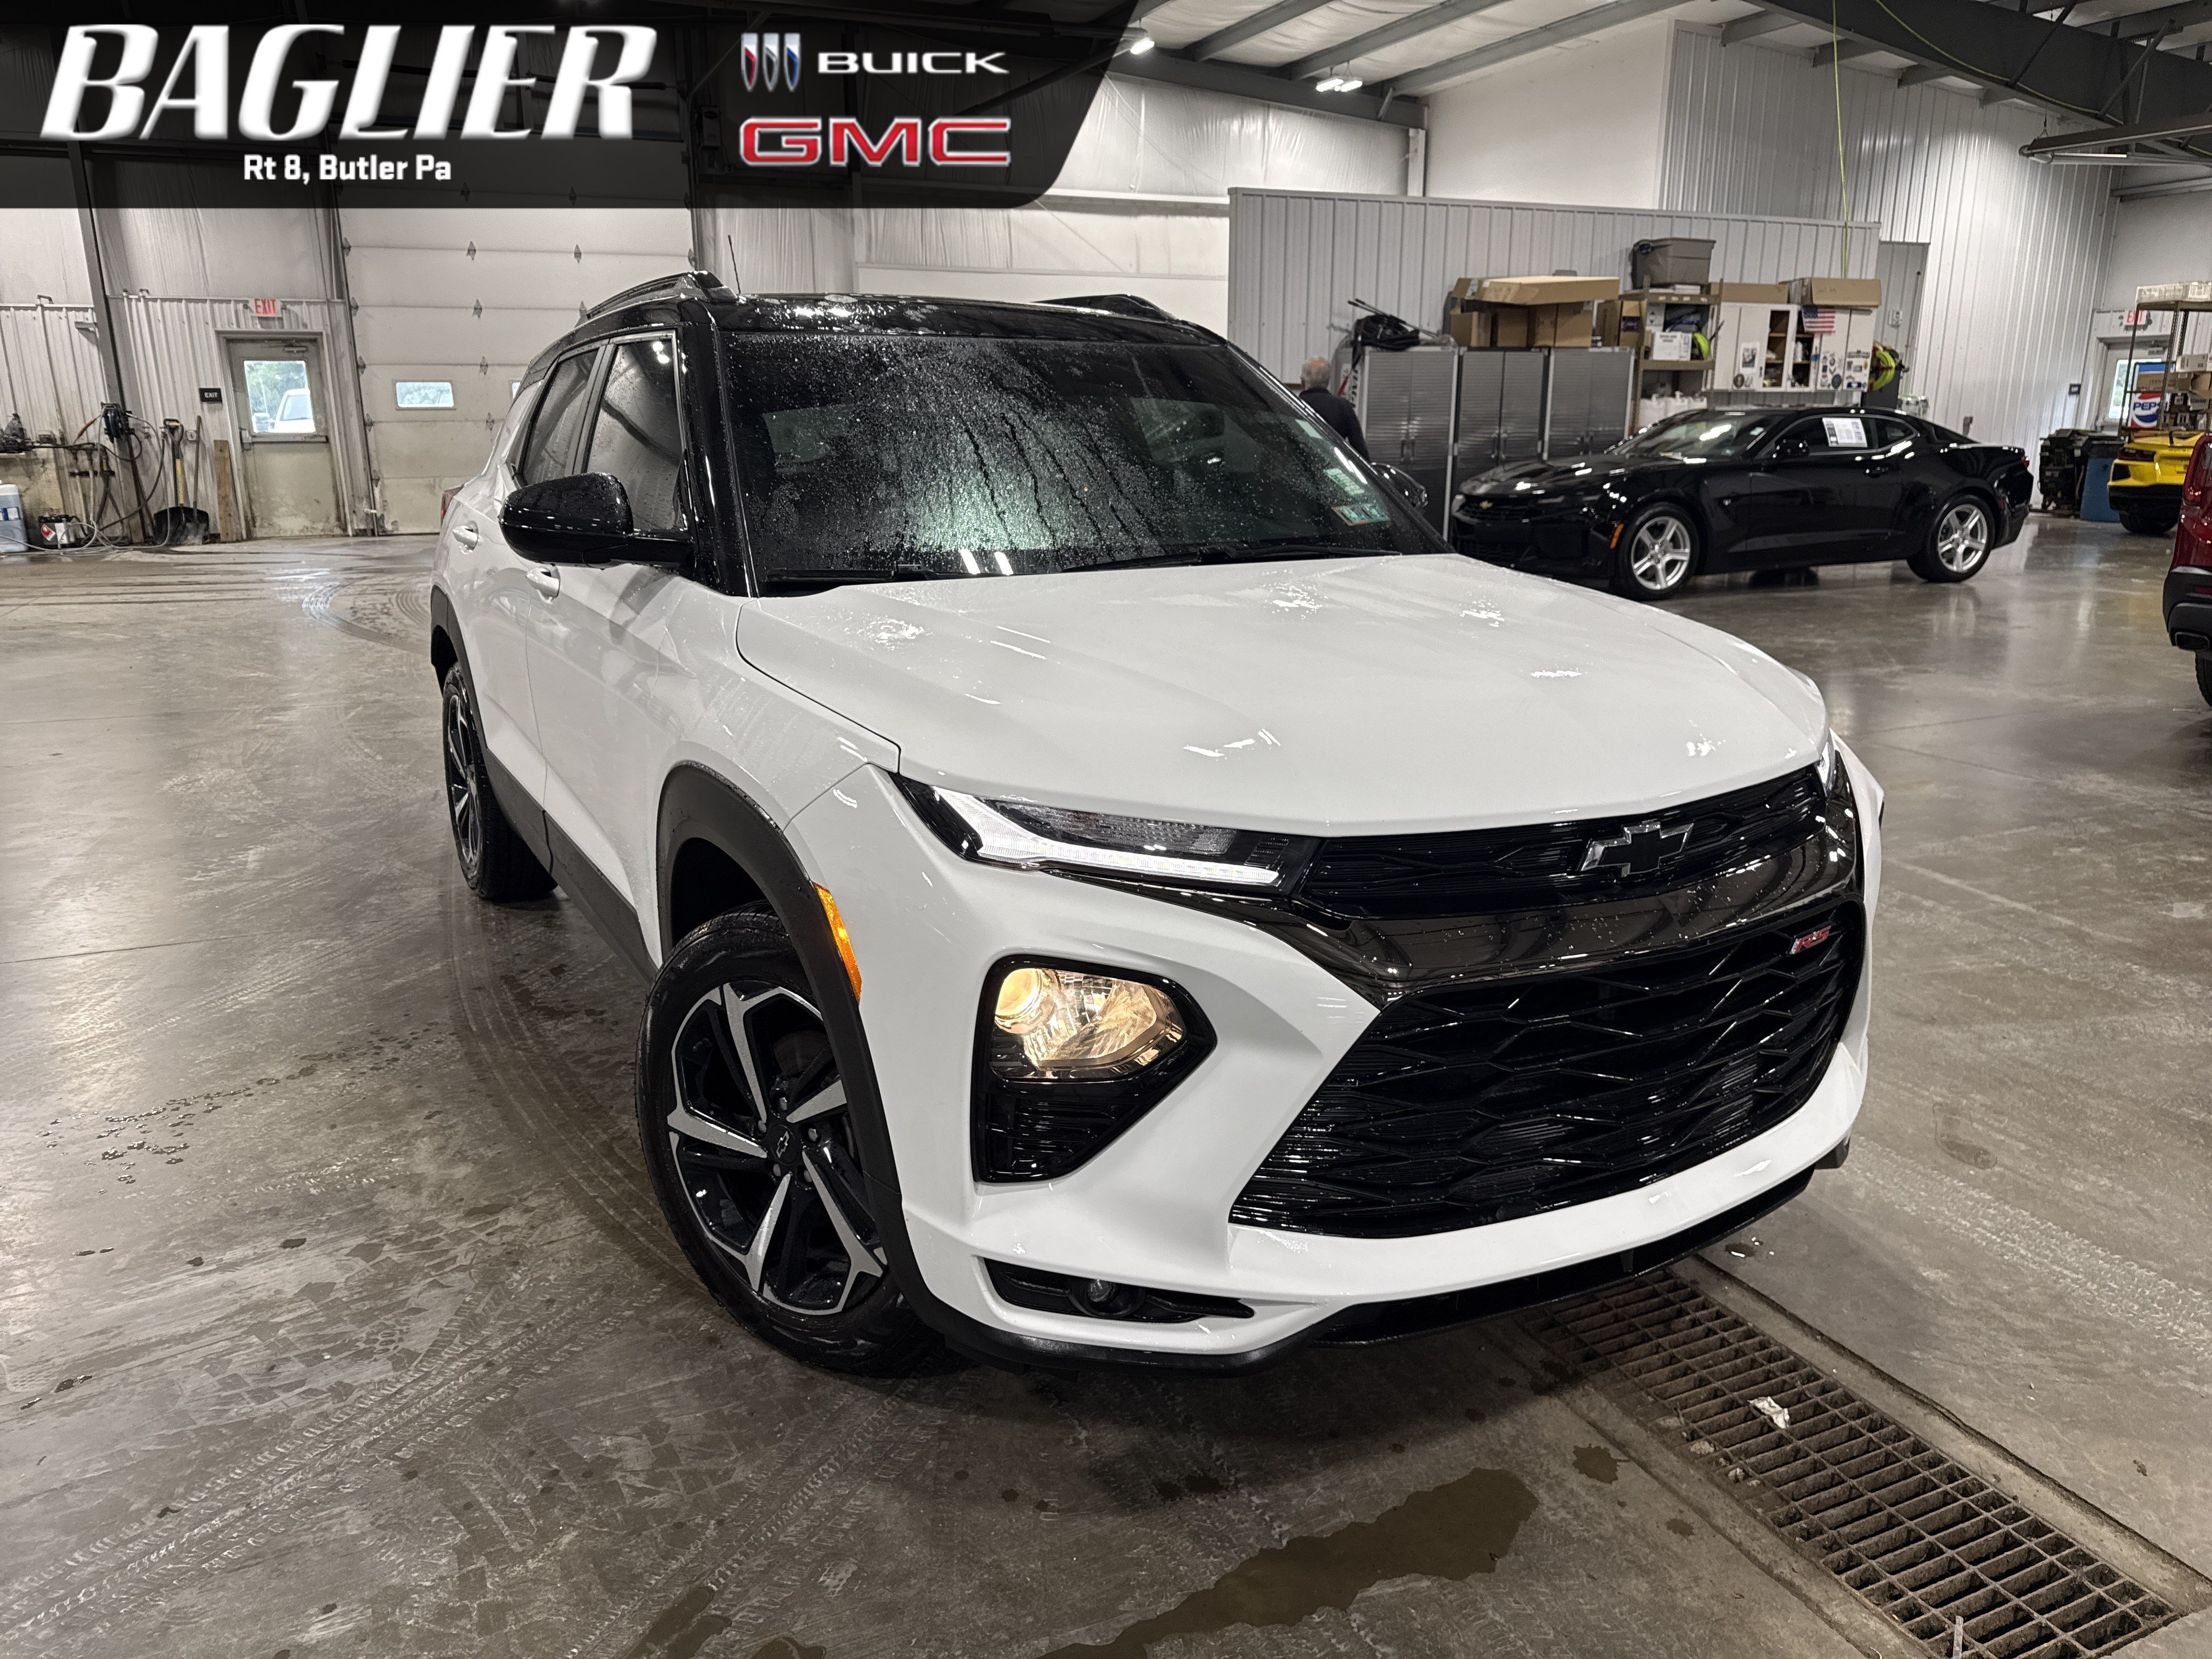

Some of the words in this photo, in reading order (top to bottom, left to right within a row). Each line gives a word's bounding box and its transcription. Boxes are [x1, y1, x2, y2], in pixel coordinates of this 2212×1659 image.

[254, 298, 277, 315] EXIT
[2132, 401, 2168, 410] PEPI
[1790, 925, 1831, 955] RS
